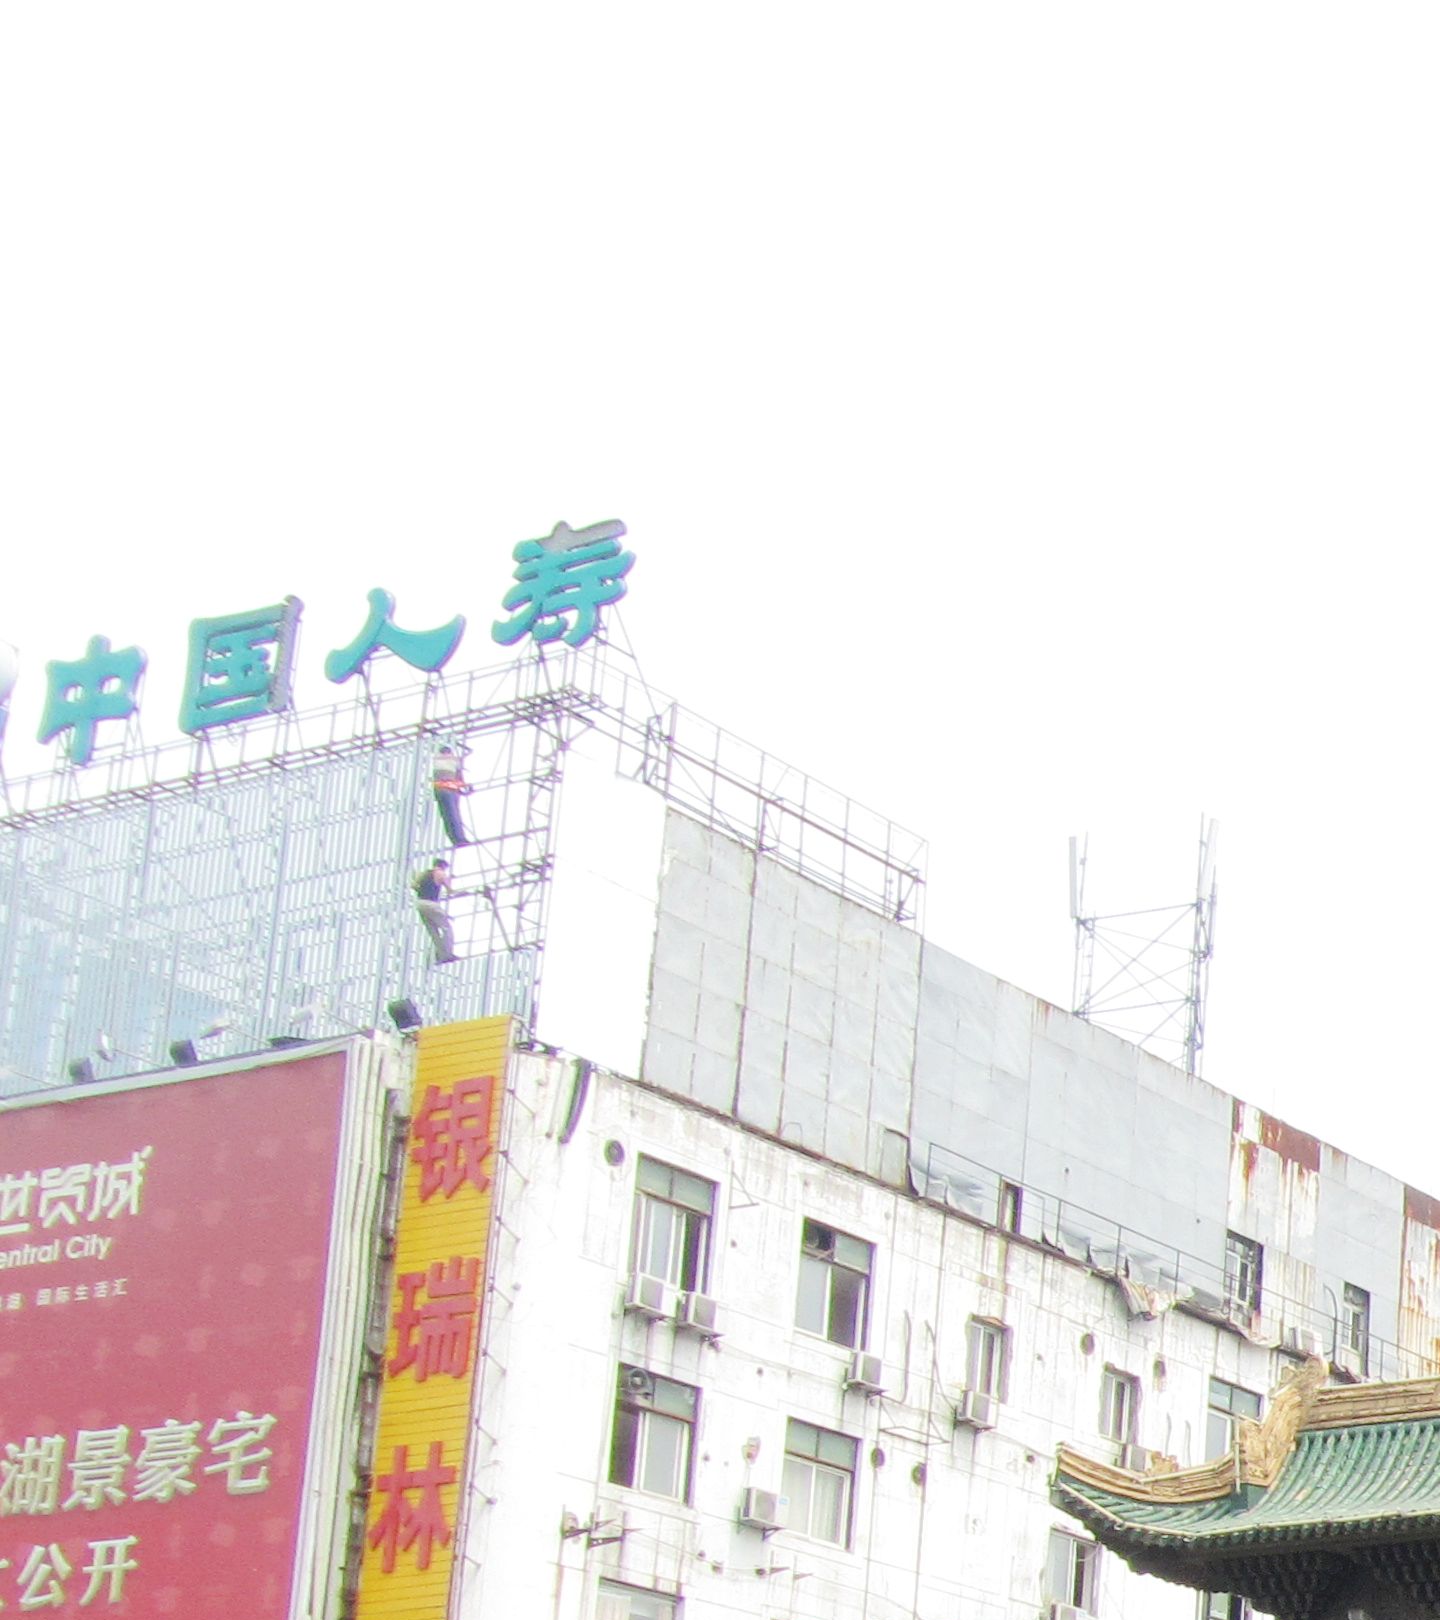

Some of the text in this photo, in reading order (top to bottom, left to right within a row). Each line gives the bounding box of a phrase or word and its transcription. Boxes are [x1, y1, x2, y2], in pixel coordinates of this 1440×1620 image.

[36, 517, 637, 766] 中国人寿
[65, 1233, 112, 1260] City
[0, 1410, 278, 1517] 湖景豪宅
[0, 1534, 140, 1613] 公开
